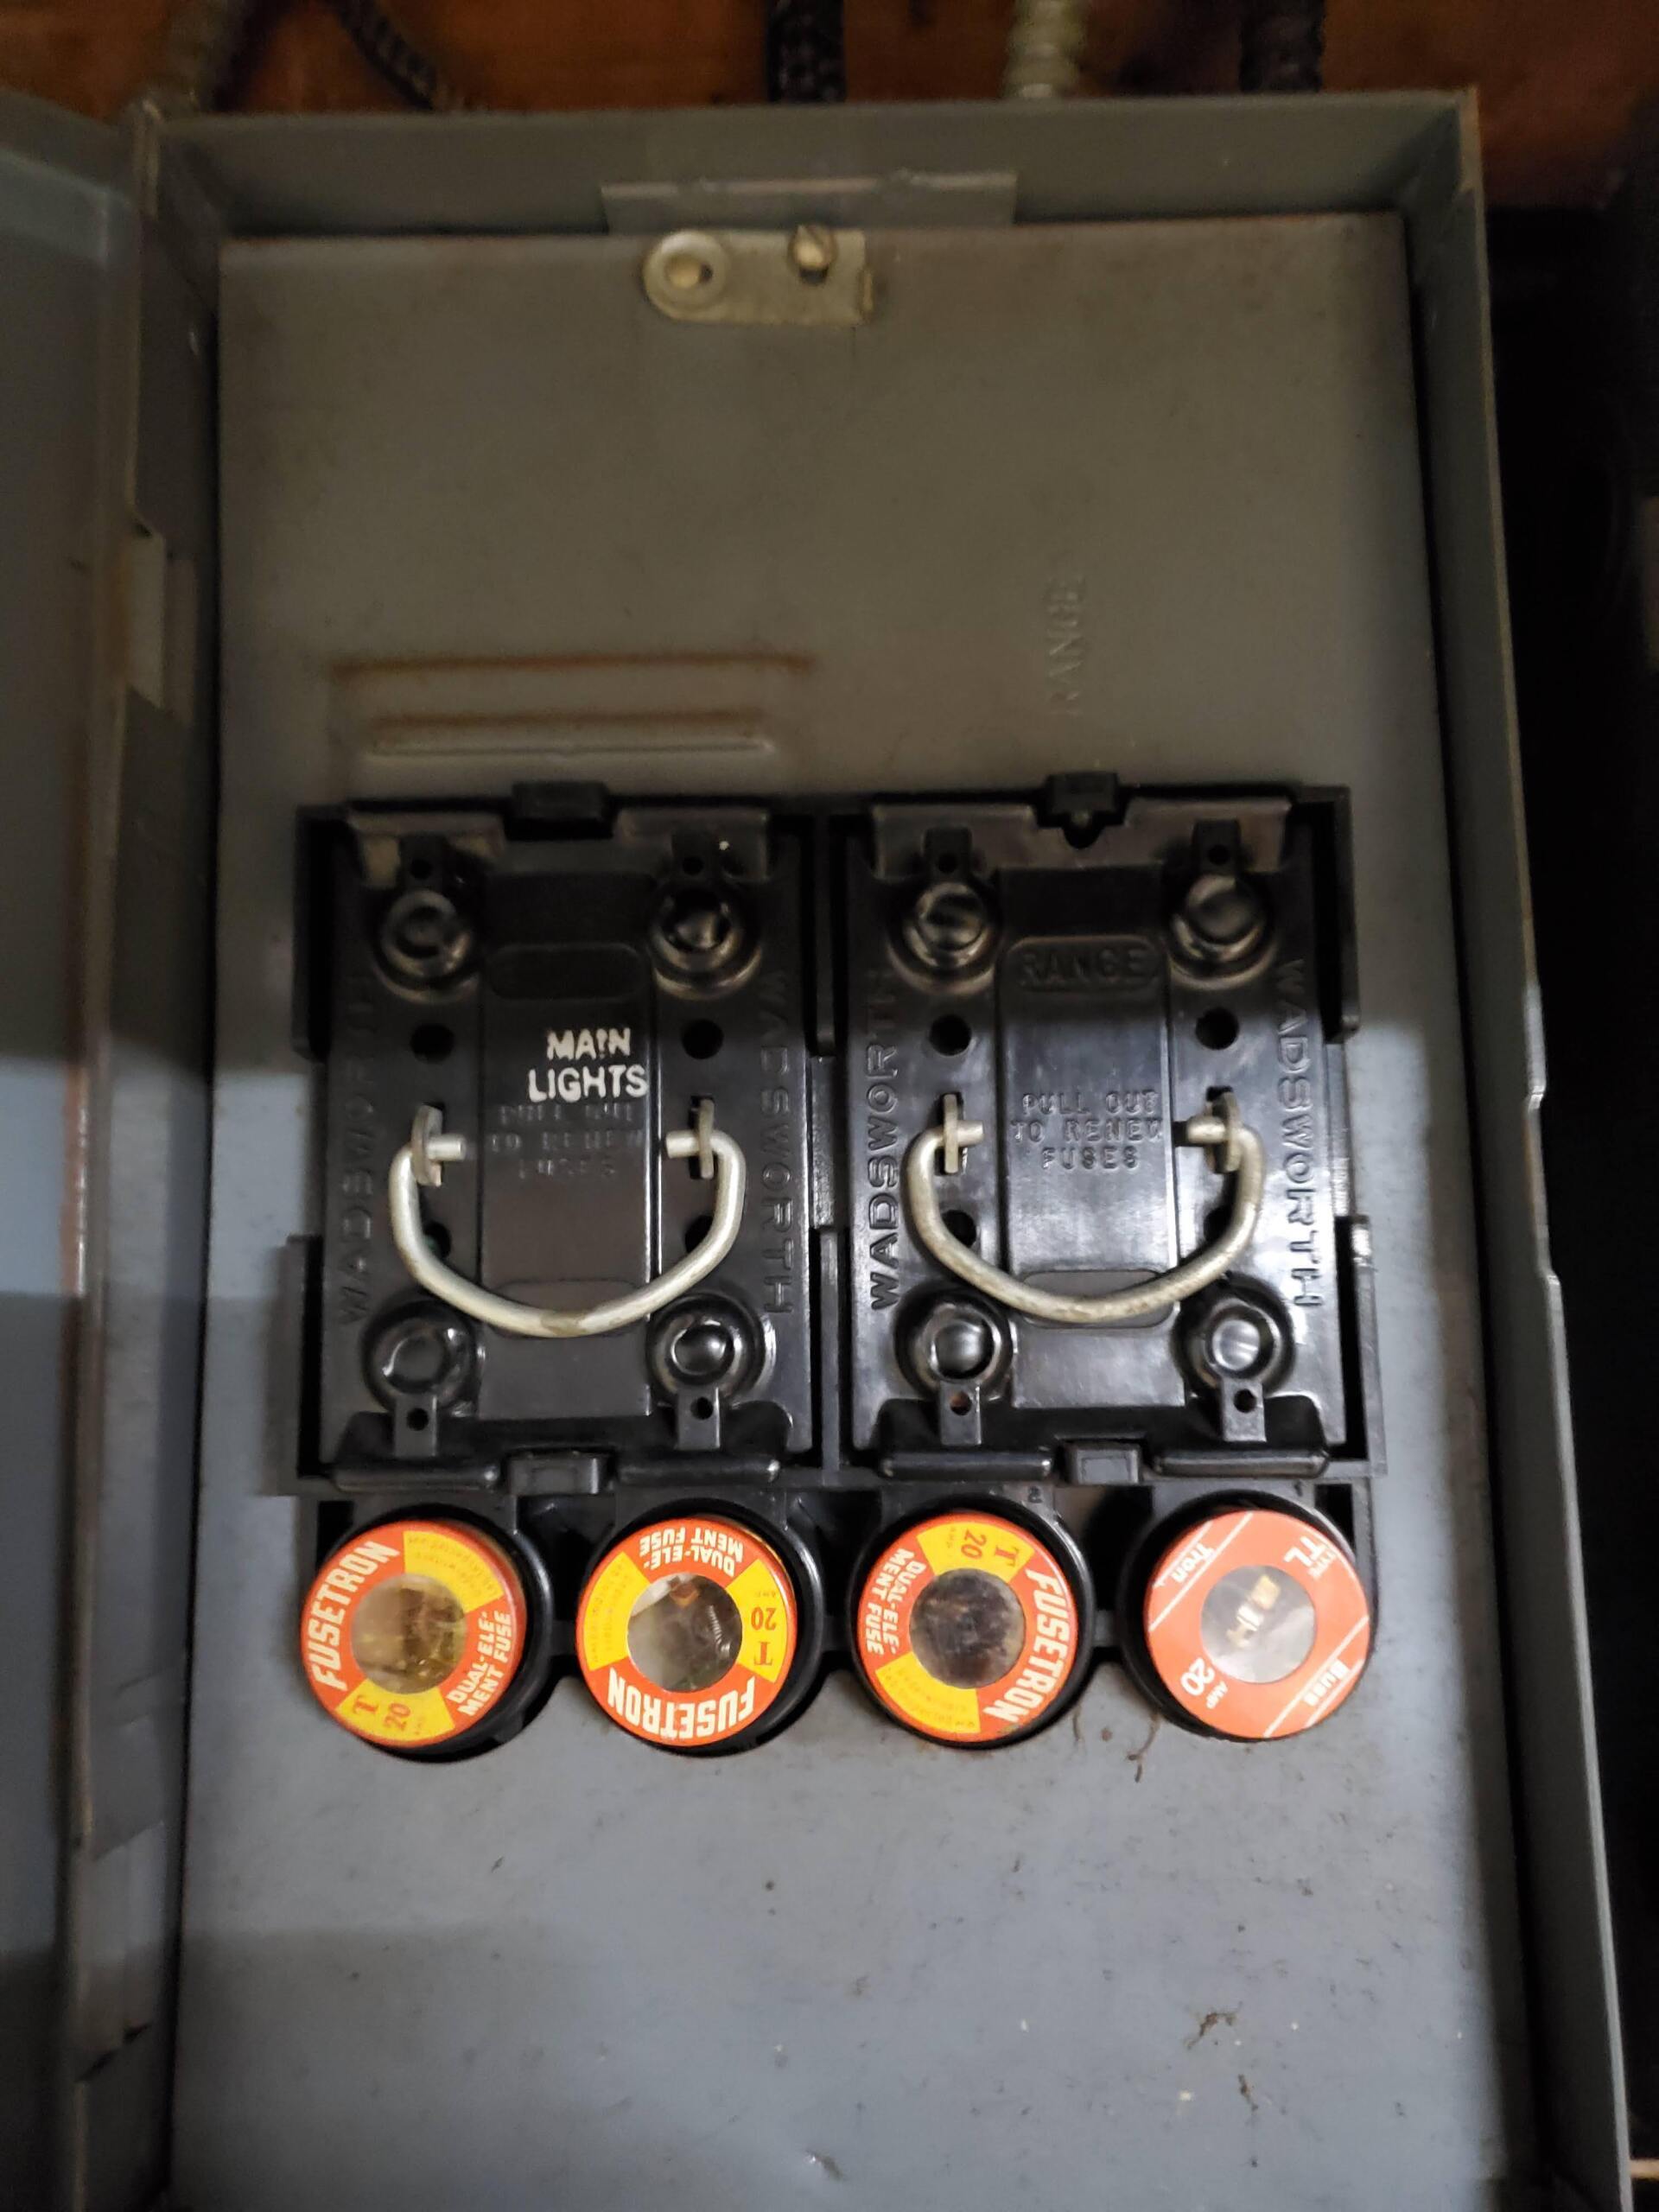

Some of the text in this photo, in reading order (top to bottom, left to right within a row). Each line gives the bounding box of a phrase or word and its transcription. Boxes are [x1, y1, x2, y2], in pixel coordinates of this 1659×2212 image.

[1020, 948, 1153, 985] RANGE
[546, 1027, 631, 1060] MAIN
[527, 1065, 649, 1103] LIGHTS
[1022, 1089, 1159, 1116] PULL OUT
[759, 968, 794, 1313] WADSWORTH
[865, 966, 900, 1311] WADSWORTH
[1009, 1118, 1163, 1144] TO RENEW
[1277, 957, 1325, 1308] WADSWORTH
[1042, 1146, 1141, 1171] FUSES
[639, 1527, 744, 1563] MENT FUSE
[961, 1529, 988, 1560] 20
[995, 1545, 1020, 1567] T
[1171, 1542, 1217, 1583] Tron
[1283, 1535, 1325, 1567] TL
[308, 1541, 401, 1691] FUSETRON
[750, 1605, 778, 1631] 20
[865, 1548, 915, 1656] MENT FUSE
[457, 1610, 512, 1716] MENT FUSE
[753, 1641, 774, 1666] T
[982, 1568, 1070, 1723] FUSETRON
[1179, 1657, 1216, 1696] 20
[353, 1694, 380, 1716] T
[382, 1702, 412, 1732] 20
[607, 1667, 756, 1740] FUSETRON
